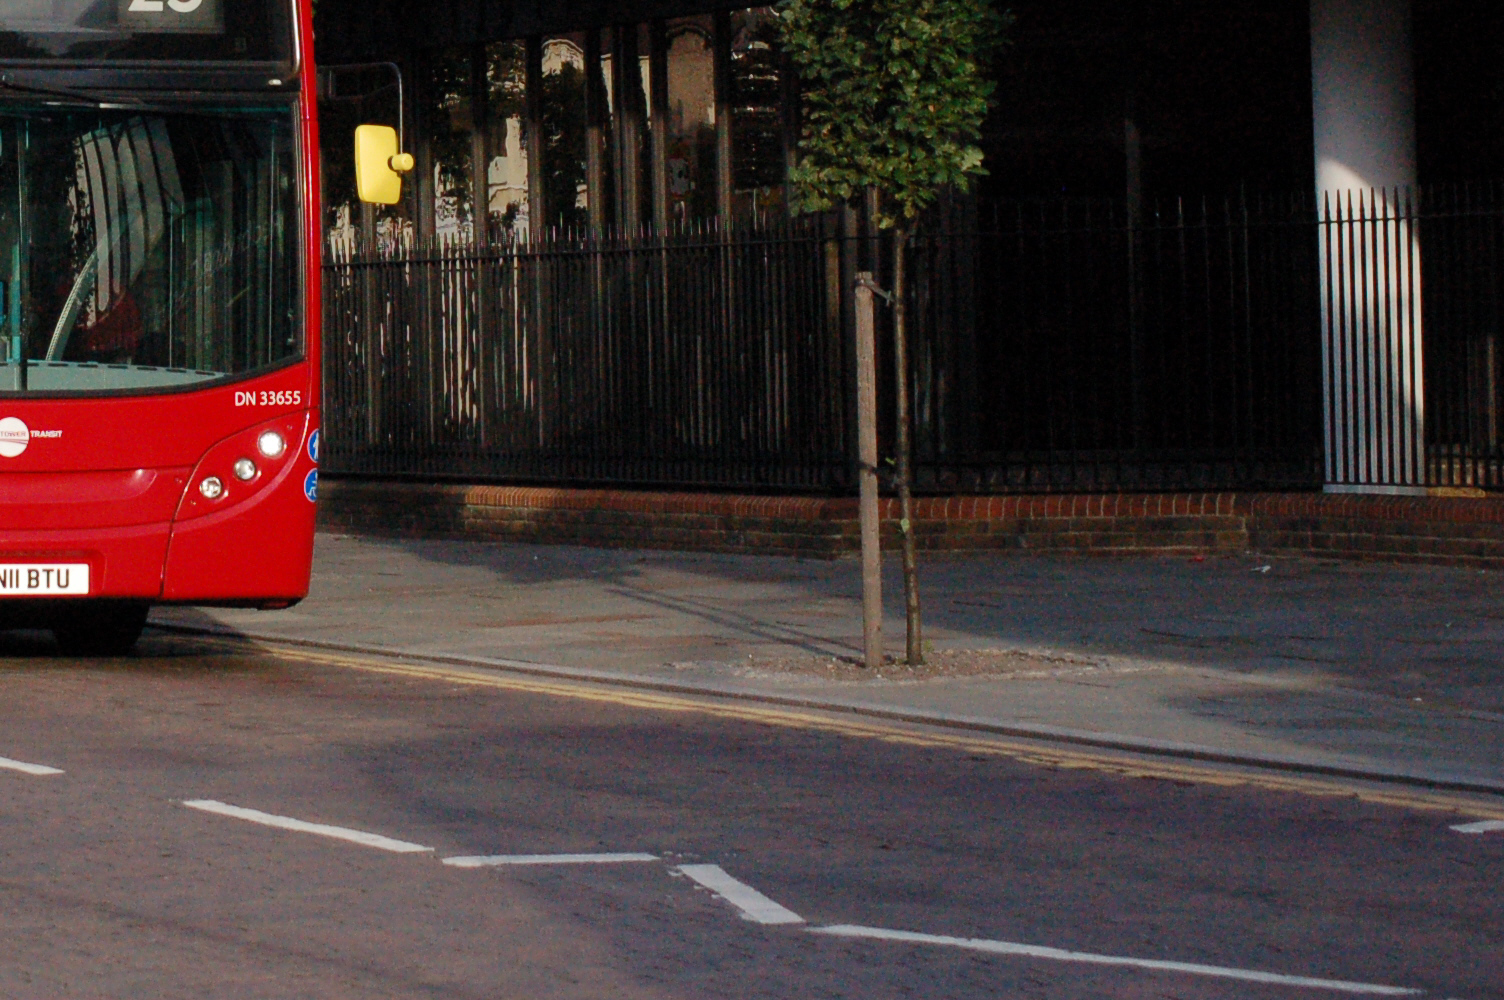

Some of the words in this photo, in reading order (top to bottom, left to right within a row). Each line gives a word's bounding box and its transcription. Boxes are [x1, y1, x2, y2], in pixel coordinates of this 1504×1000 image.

[234, 391, 256, 407] DN
[259, 390, 301, 406] 33655
[0, 430, 26, 438] TOWER
[30, 429, 63, 438] TRANSIT
[27, 568, 69, 589] BTU
